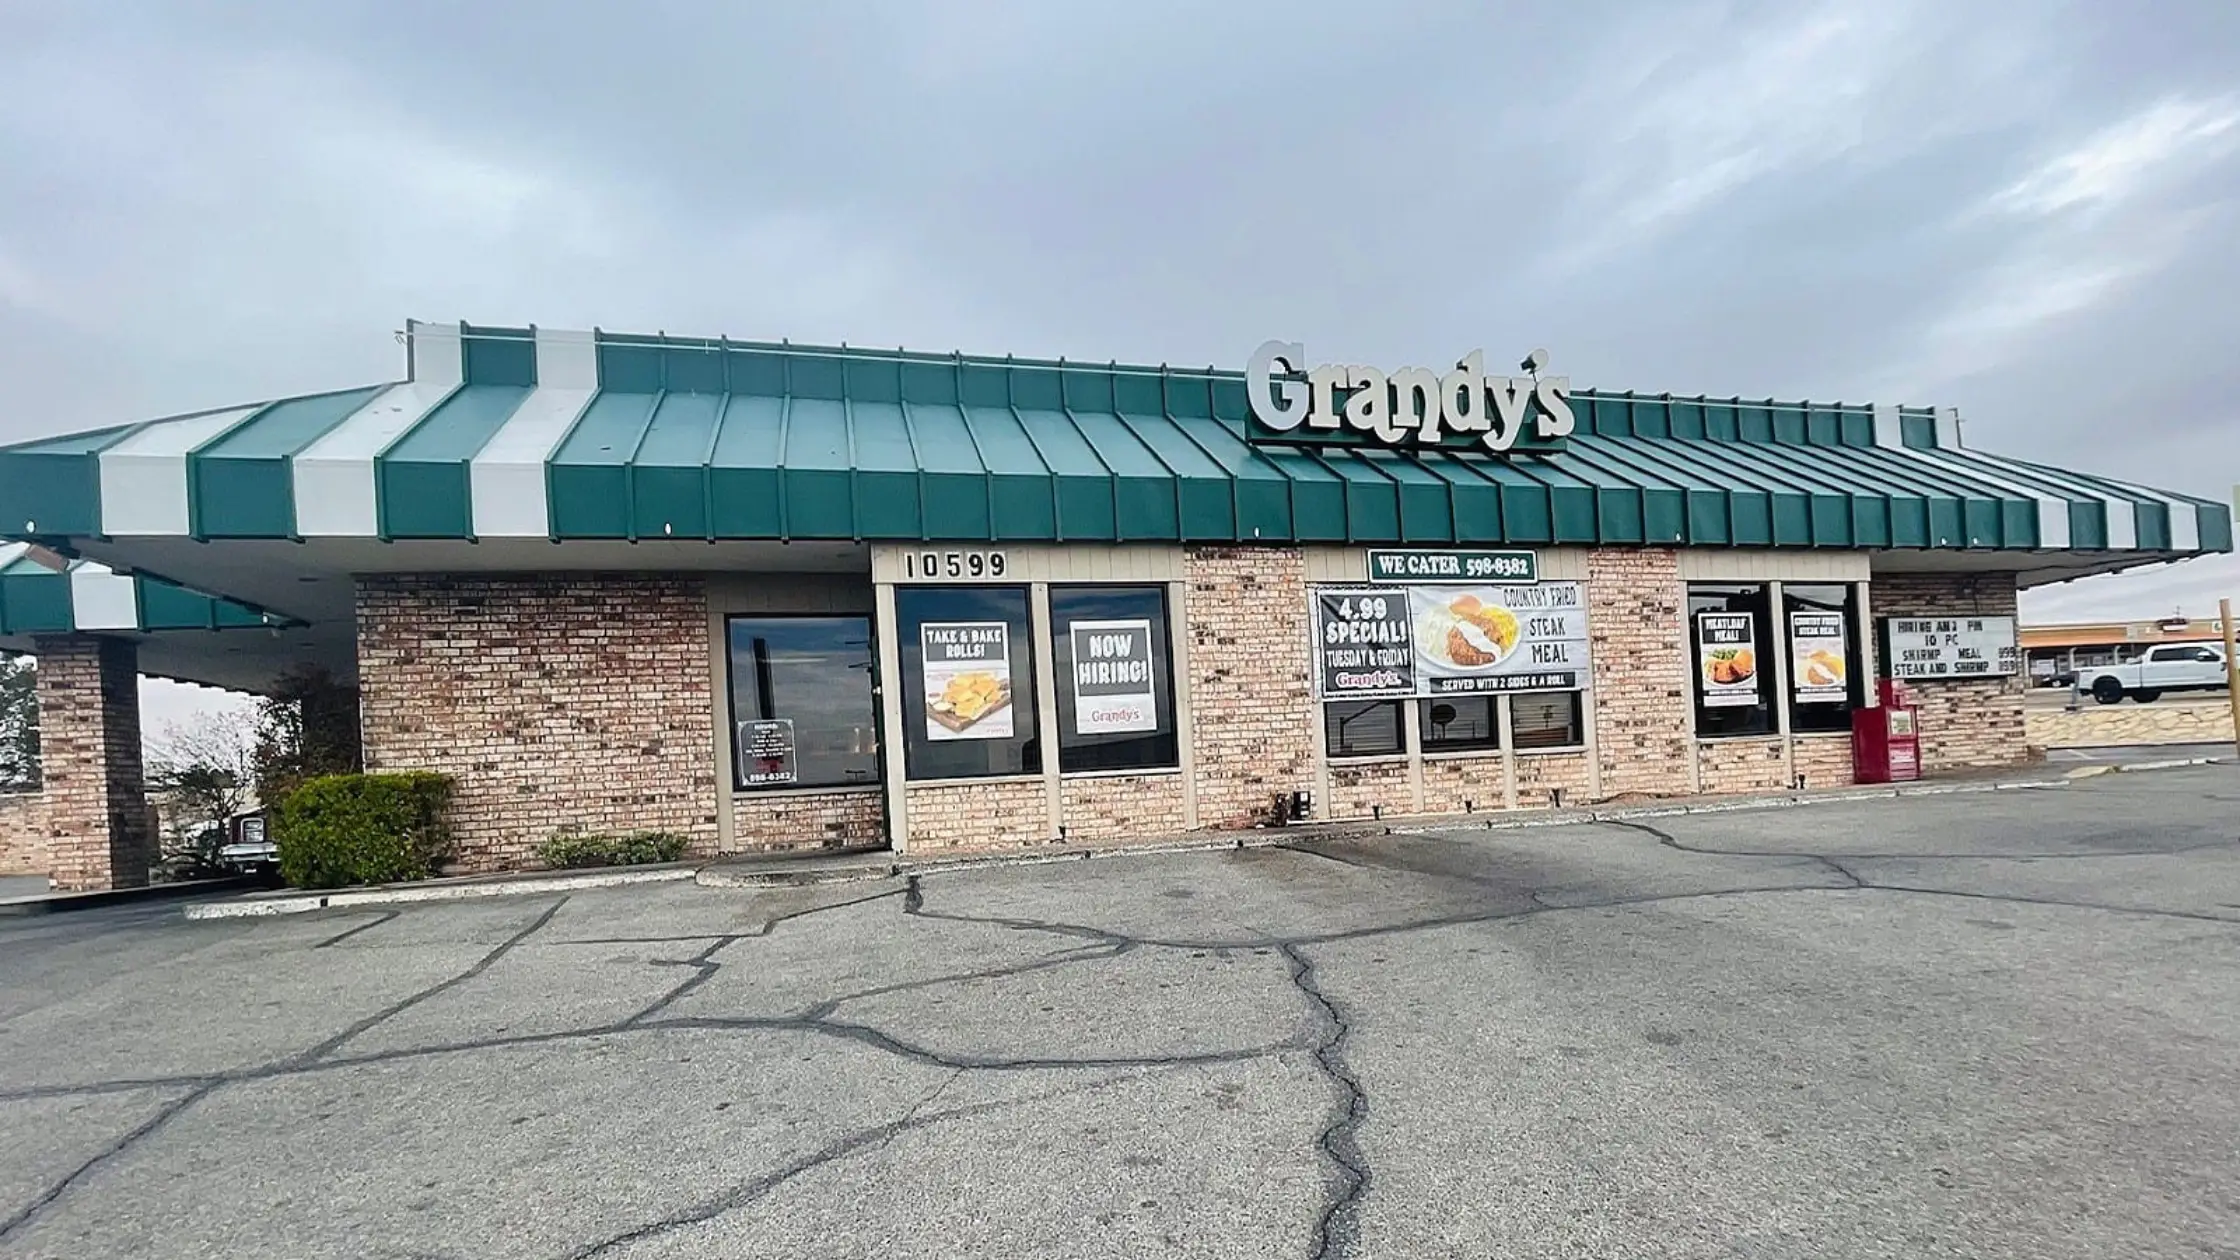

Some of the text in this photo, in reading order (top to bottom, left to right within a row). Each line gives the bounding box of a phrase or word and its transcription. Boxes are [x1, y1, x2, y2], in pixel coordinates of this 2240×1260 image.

[1247, 339, 1575, 450] Grandy's
[906, 553, 1005, 578] 10599
[1378, 555, 1529, 576] WE CATER 598-8382
[1504, 586, 1577, 607] COUNTRY FRIED
[1339, 597, 1387, 620] 4.99
[927, 629, 1001, 644] TAKE & BAKE
[1326, 620, 1407, 643] SPECIAL!
[1529, 617, 1566, 636] STEAK
[1089, 634, 1132, 658] NOW
[1925, 633, 1958, 646] 10 PC
[945, 643, 985, 658] ROLLS!
[1326, 649, 1367, 667] TUESDAY
[1377, 648, 1408, 666] FRIDAY
[1531, 643, 1569, 663] MEAL
[1958, 647, 1981, 659] MEAL
[1079, 660, 1148, 684] HIRING!
[1894, 663, 1926, 676] STEAK
[1441, 679, 1474, 691] SERVED
[1476, 677, 1498, 689] WITH
